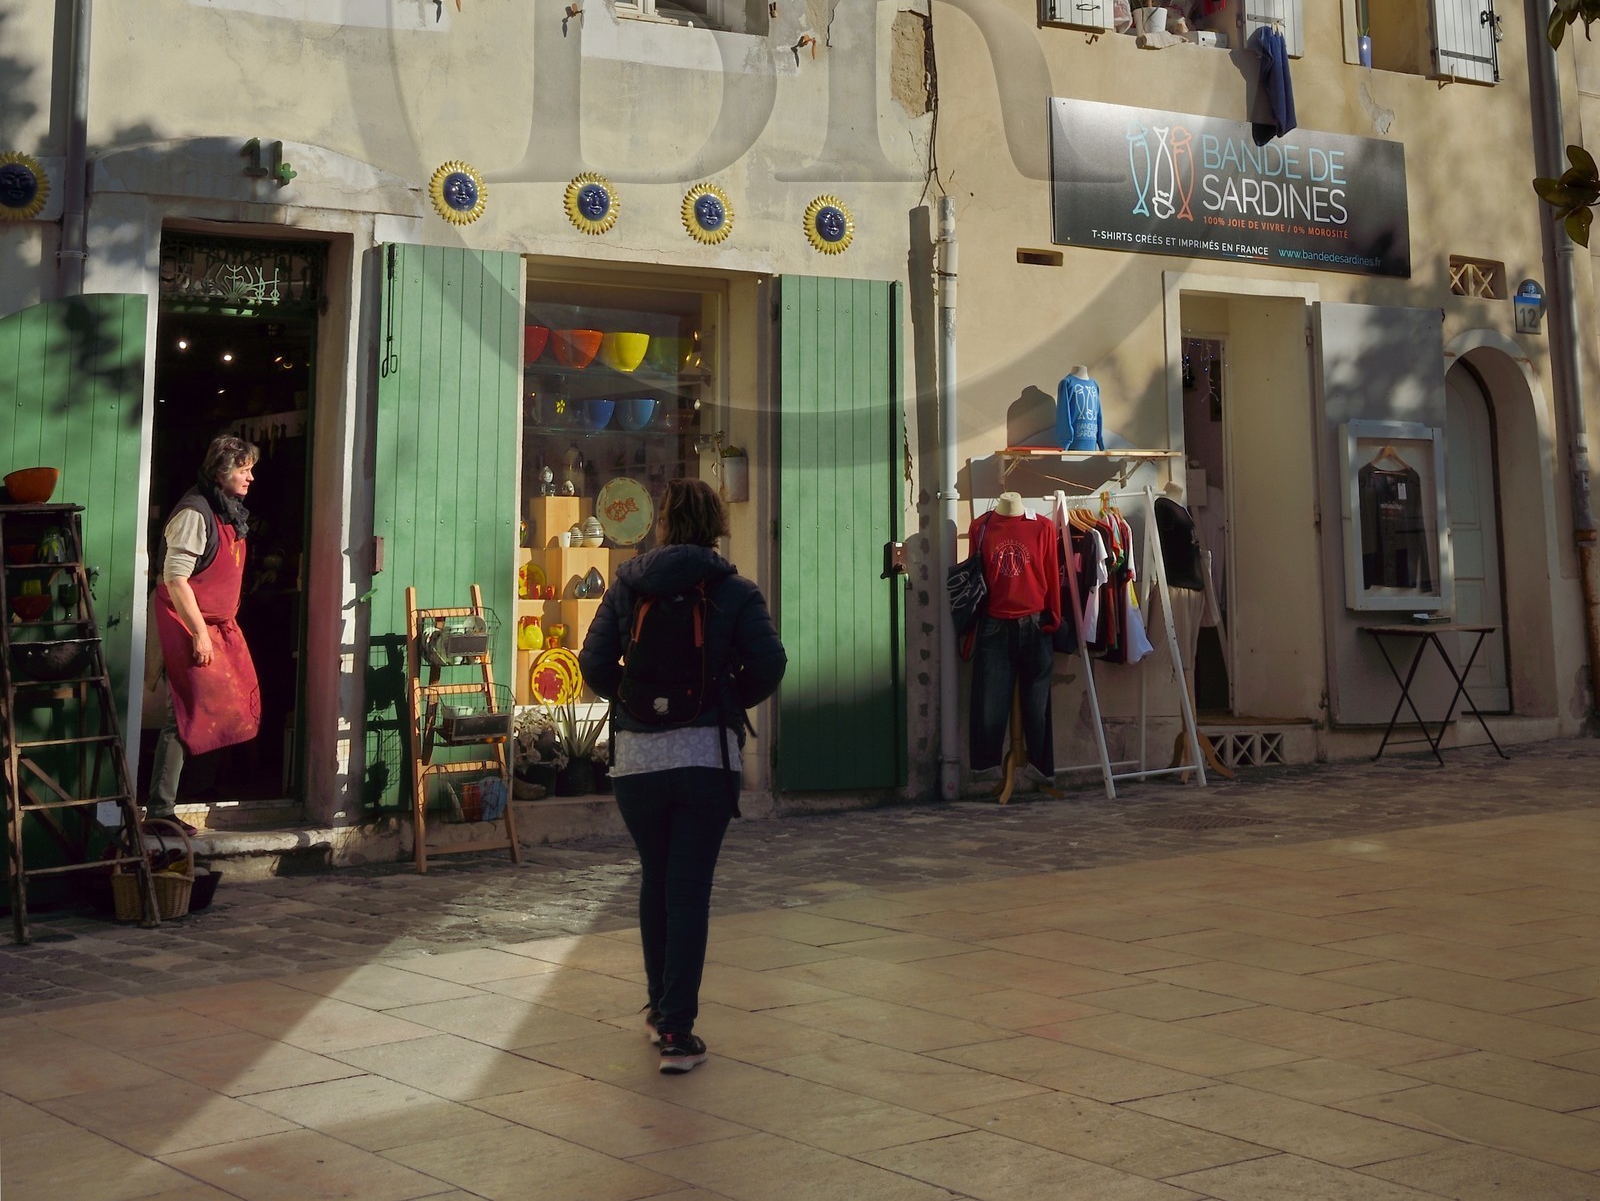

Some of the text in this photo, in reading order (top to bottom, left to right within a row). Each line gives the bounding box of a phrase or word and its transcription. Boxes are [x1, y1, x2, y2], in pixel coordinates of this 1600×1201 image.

[1202, 134, 1347, 185] BANDE DE
[1202, 173, 1349, 225] SARDINES
[1203, 215, 1226, 227] 100%
[1227, 218, 1246, 229] JOIE
[1248, 220, 1259, 230] DE
[1261, 222, 1285, 233] VIVRE
[1293, 225, 1306, 235] 0%
[1307, 226, 1349, 239] MOROSITÉ
[1091, 229, 1382, 268] T-SHIRTS CRÉÉS ET IMPRIMÉS EN FRANCE www.bandedesardines.fr
[1520, 307, 1537, 328] 12
